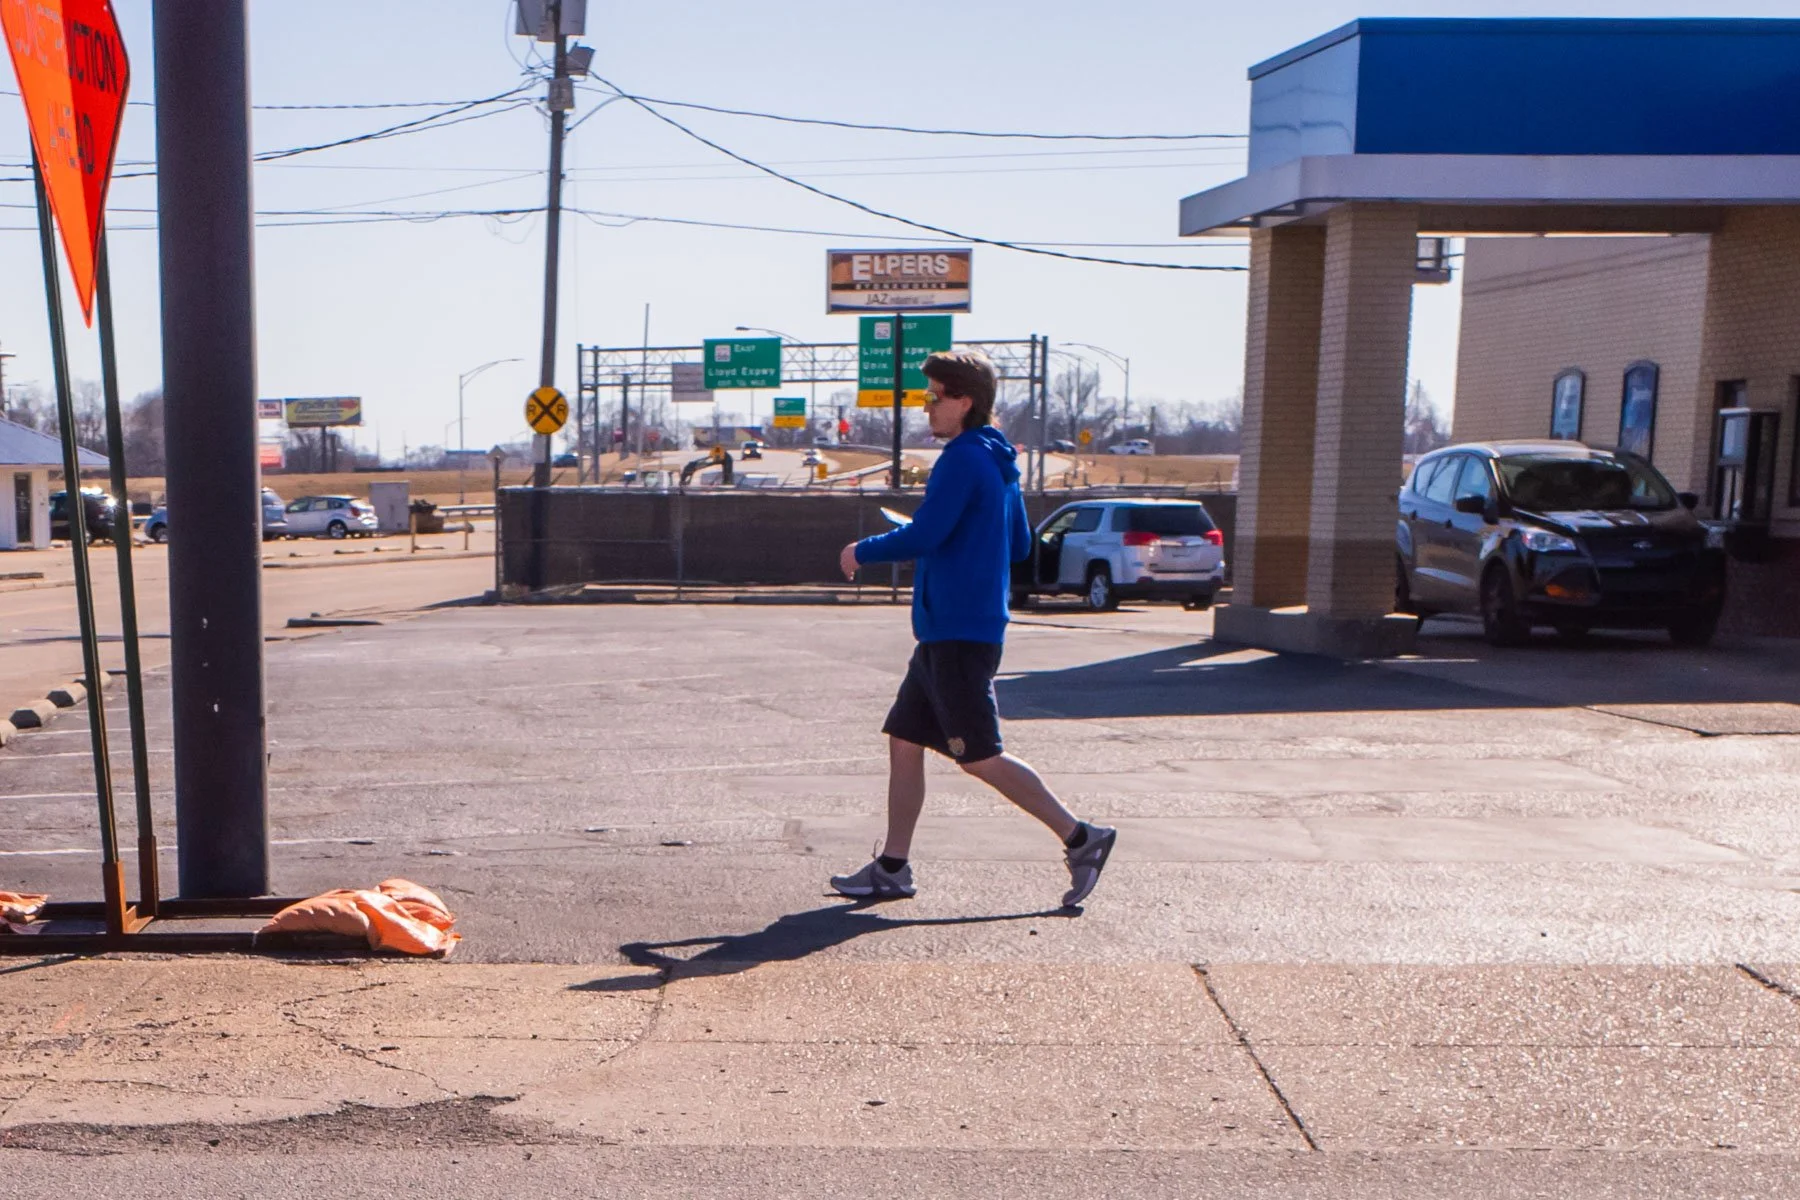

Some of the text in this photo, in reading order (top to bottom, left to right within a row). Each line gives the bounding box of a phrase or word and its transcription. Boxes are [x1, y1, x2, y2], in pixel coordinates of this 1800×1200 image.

[852, 254, 950, 281] ELPERS
[866, 293, 889, 305] JAZ
[707, 366, 776, 377] Lloyd Expwy
[527, 403, 566, 417] R R
